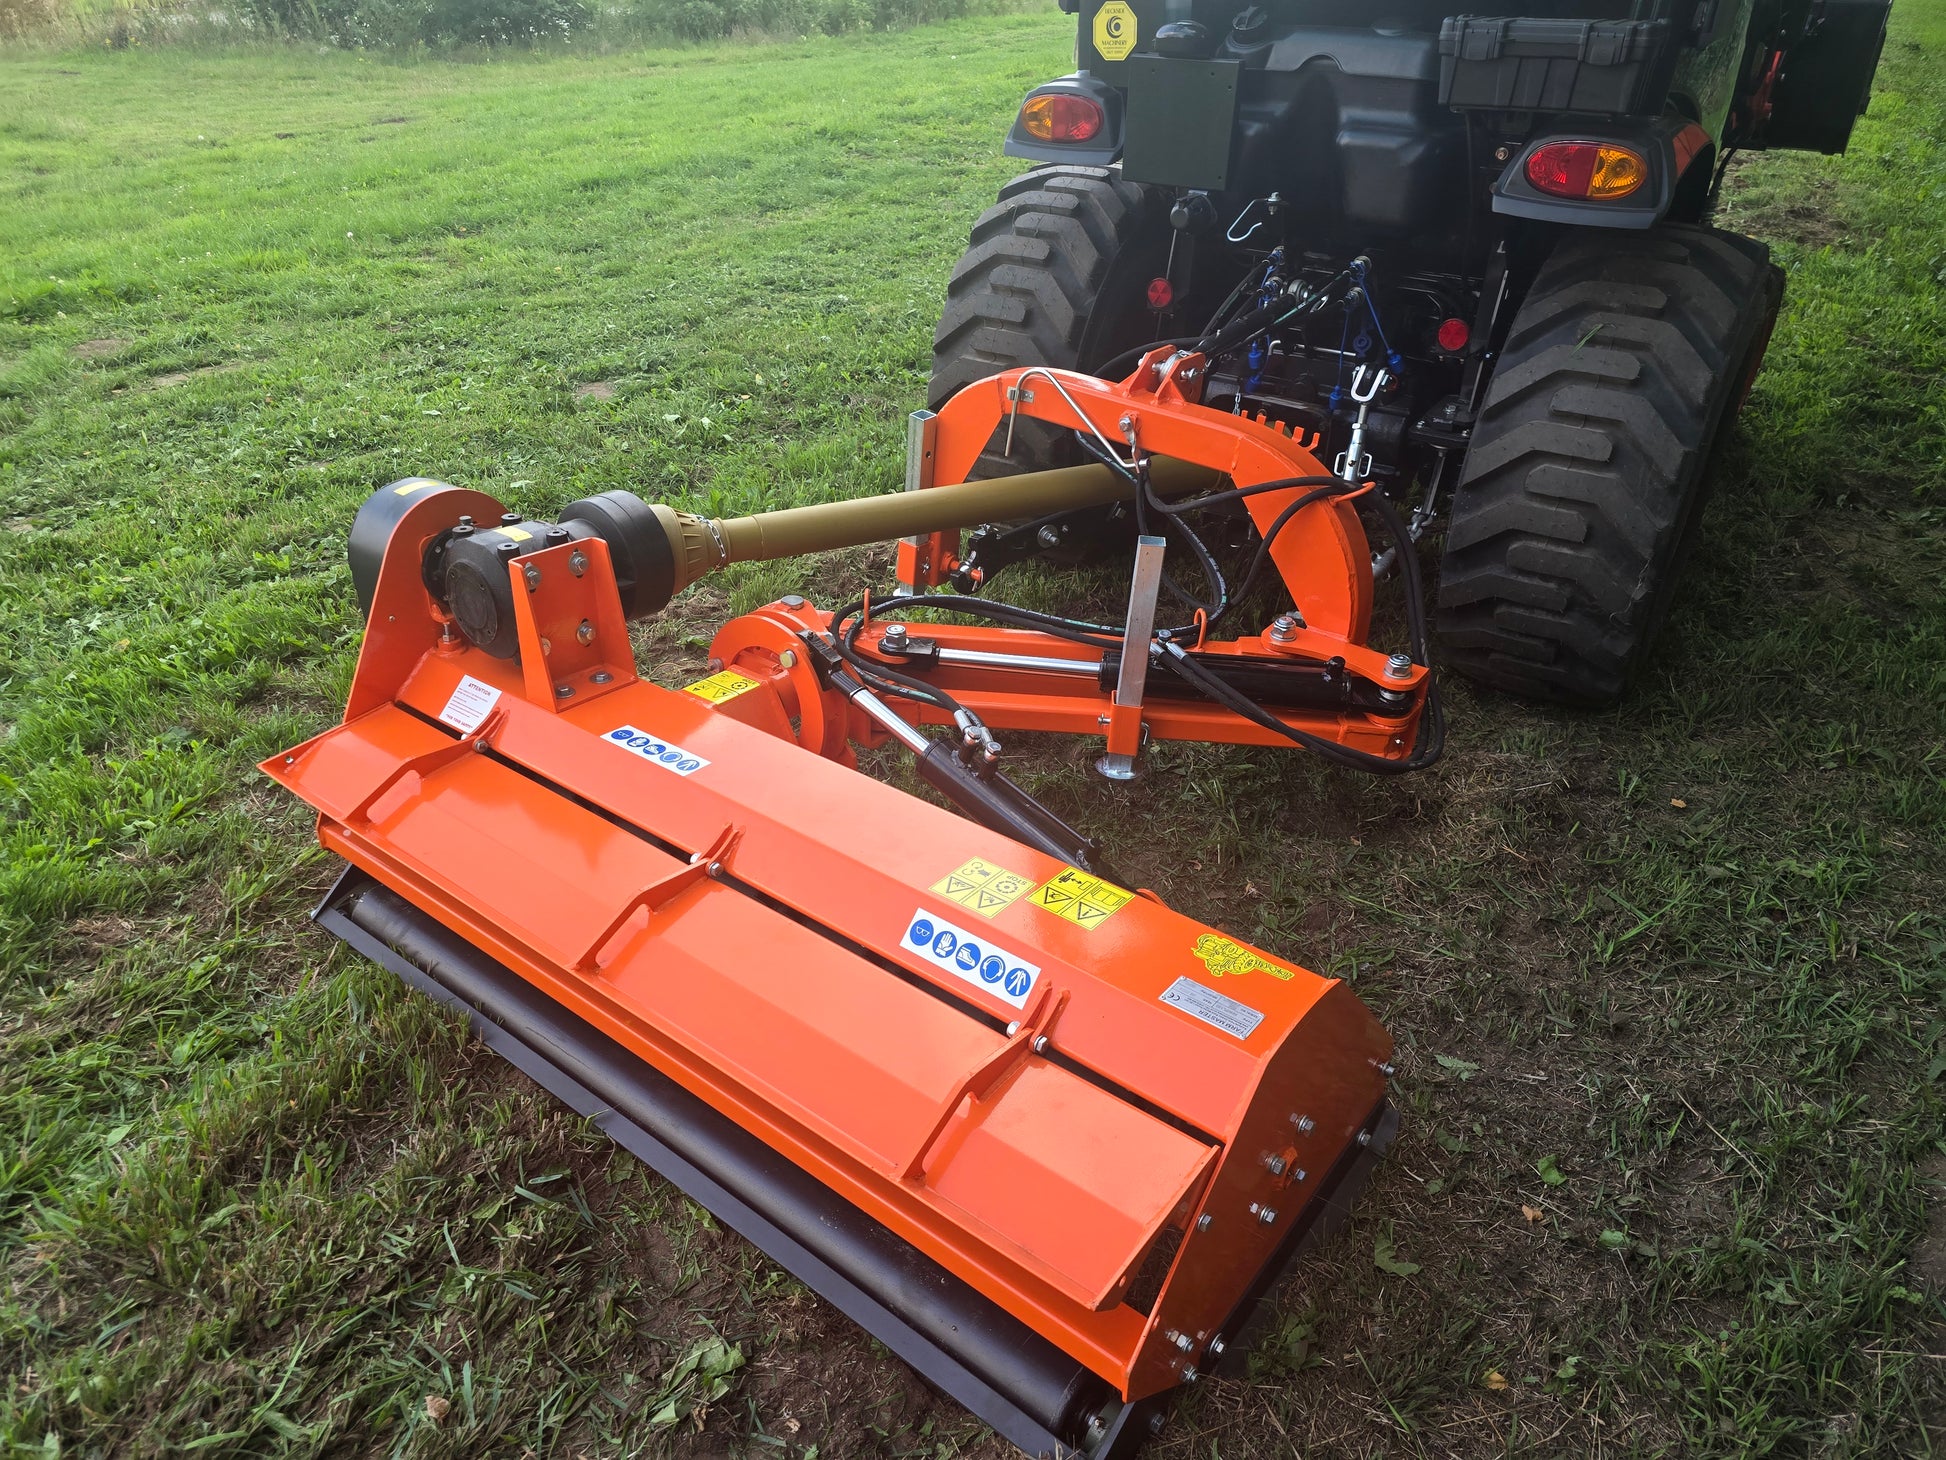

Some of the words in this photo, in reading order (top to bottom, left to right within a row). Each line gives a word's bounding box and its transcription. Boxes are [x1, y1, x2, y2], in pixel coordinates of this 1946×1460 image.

[468, 682, 491, 696] ATTENTION
[1006, 875, 1028, 885] STOP
[1198, 1009, 1225, 1025] MASTER
[1224, 1022, 1245, 1034] FARM
